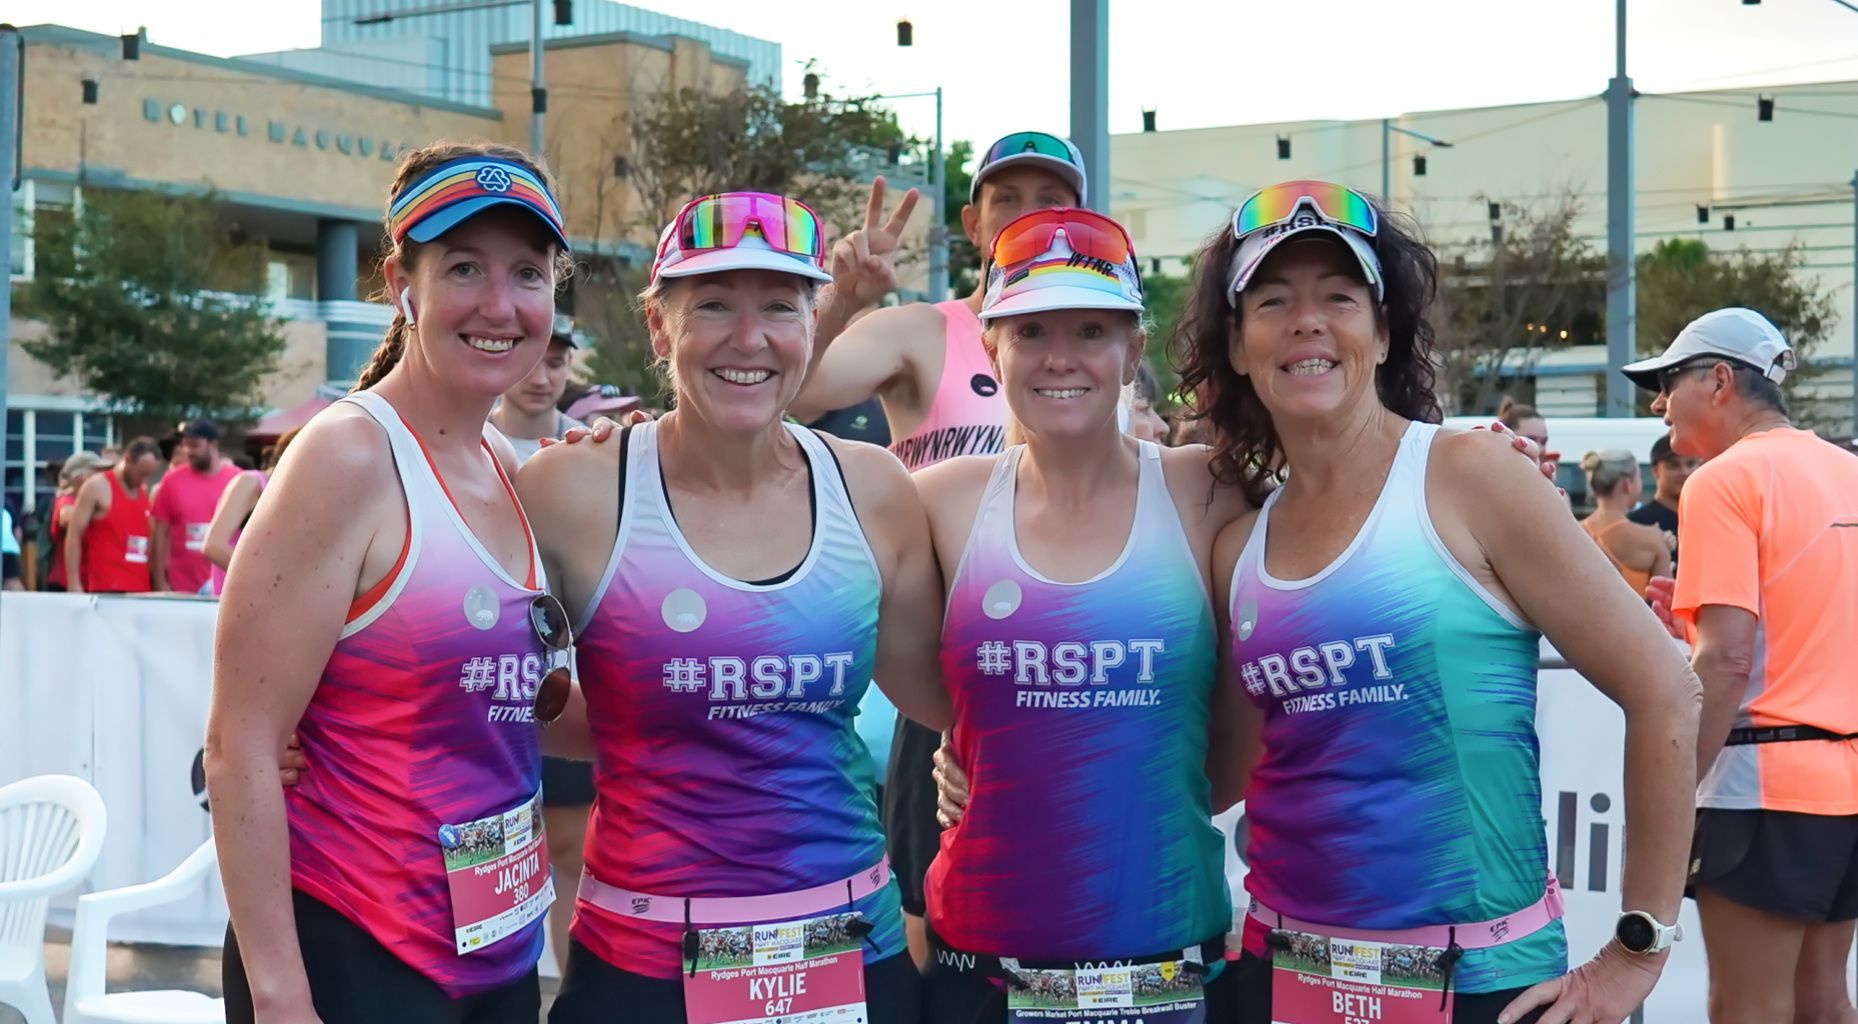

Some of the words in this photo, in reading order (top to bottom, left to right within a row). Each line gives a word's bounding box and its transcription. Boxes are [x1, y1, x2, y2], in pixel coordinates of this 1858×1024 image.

[977, 639, 1164, 685] #RSPT
[1241, 633, 1396, 698] #RSPT
[459, 653, 543, 701] #RS
[663, 651, 854, 701] #RSPT
[707, 702, 784, 720] FITNESS
[1016, 691, 1091, 708] FITNESS
[1093, 689, 1161, 706] FAMILY.
[1282, 693, 1336, 715] FITNESS
[1338, 683, 1409, 707] FAMILY.
[495, 851, 540, 895] JACINTA
[513, 882, 529, 905] 380
[711, 970, 739, 981] Rydges
[741, 968, 756, 977] Port
[758, 964, 793, 975] Macquarie
[795, 961, 808, 971] Half
[809, 957, 838, 968] Marathon
[750, 973, 806, 1000] KYLIE
[1297, 973, 1320, 986] Rydges
[1322, 979, 1335, 988] Port
[1336, 980, 1370, 993] Macquarie
[1371, 986, 1386, 995] Half
[1387, 988, 1423, 999] Marathon
[765, 997, 793, 1016] 647
[1015, 1009, 1044, 1018] Growers
[1044, 1010, 1067, 1018] Market
[1067, 1010, 1082, 1018] Port
[1083, 1009, 1118, 1018] Macquarie
[1120, 1008, 1140, 1016] Treble
[1174, 1002, 1197, 1011] Buster
[1332, 991, 1382, 1020] BETH
